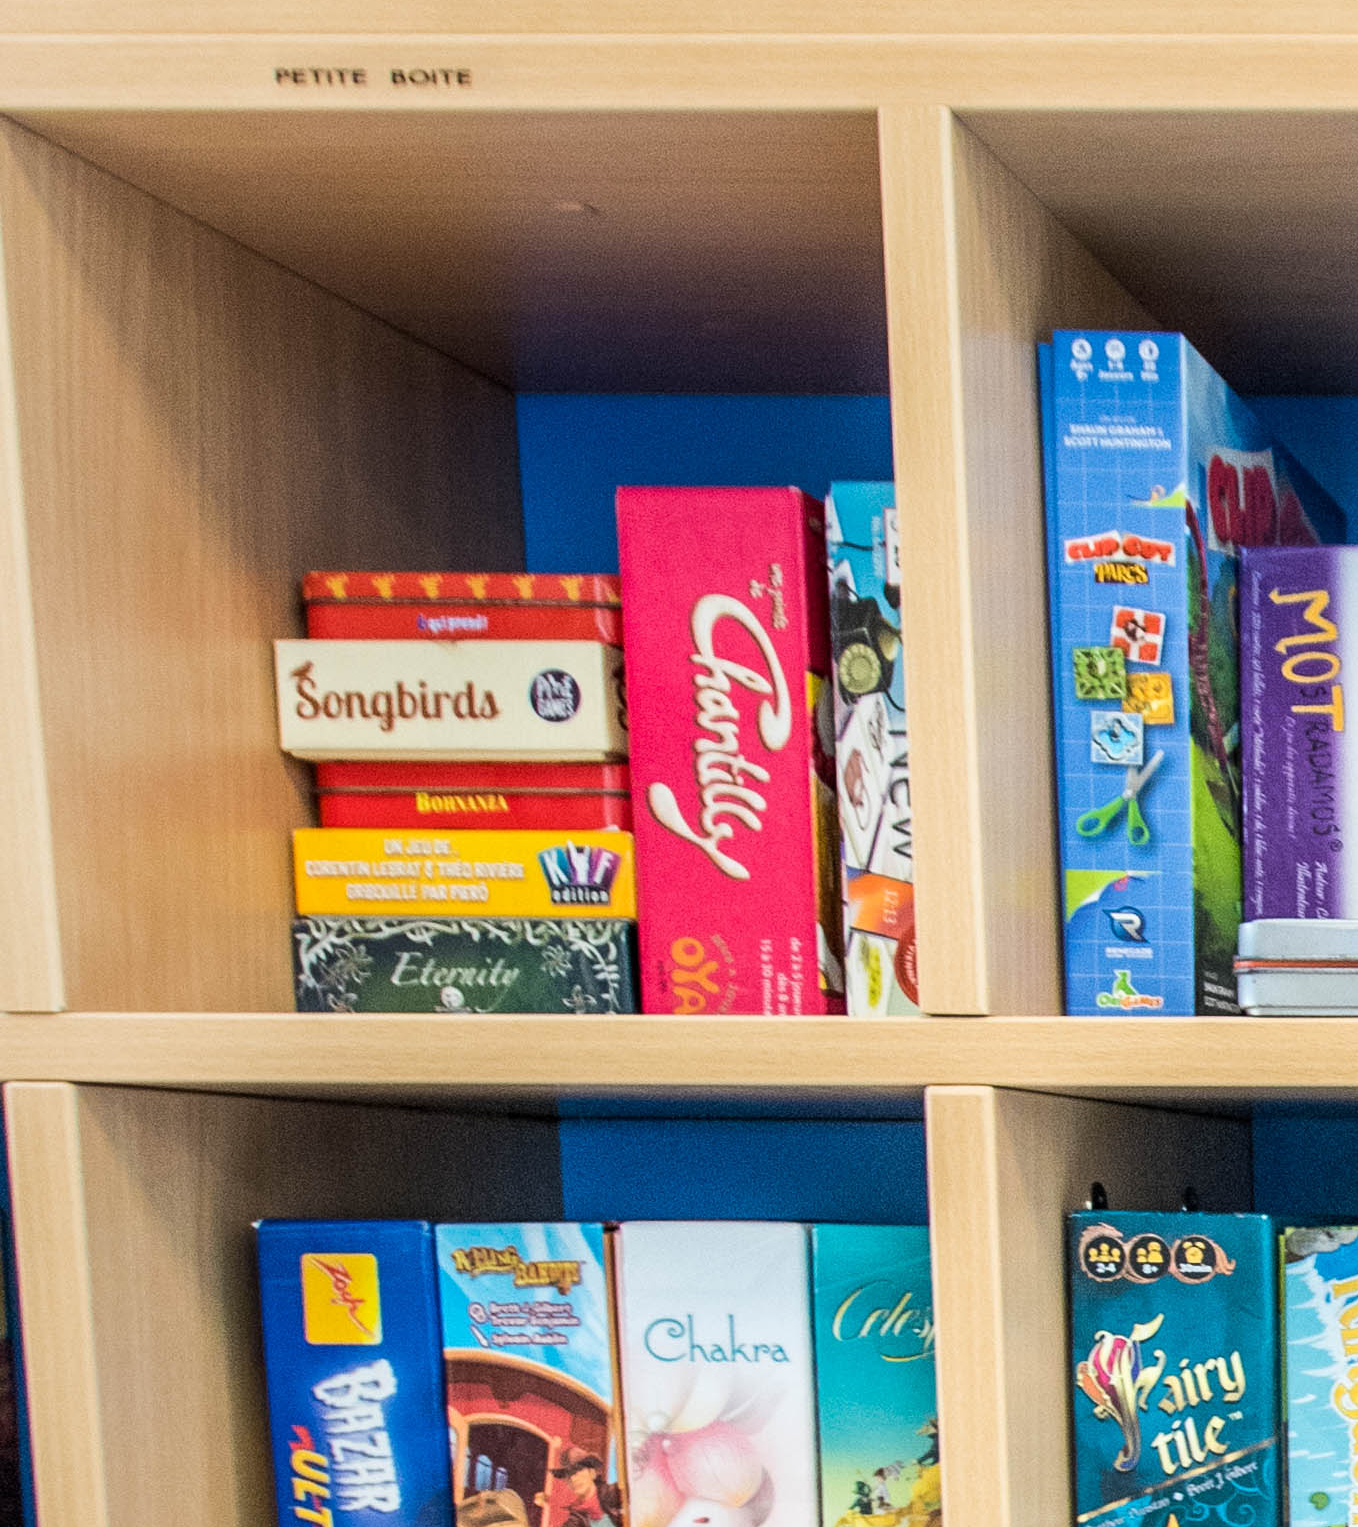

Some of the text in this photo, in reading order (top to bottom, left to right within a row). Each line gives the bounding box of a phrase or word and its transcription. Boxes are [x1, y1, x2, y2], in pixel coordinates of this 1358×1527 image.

[273, 67, 474, 86] PETITE BOITE
[291, 661, 501, 733] Songbirds
[646, 593, 792, 880] Chantilly
[391, 949, 521, 989] Eternity
[643, 1316, 792, 1365] Chakra
[312, 1358, 398, 1516] BAZAR
[1149, 1410, 1231, 1476] tile
